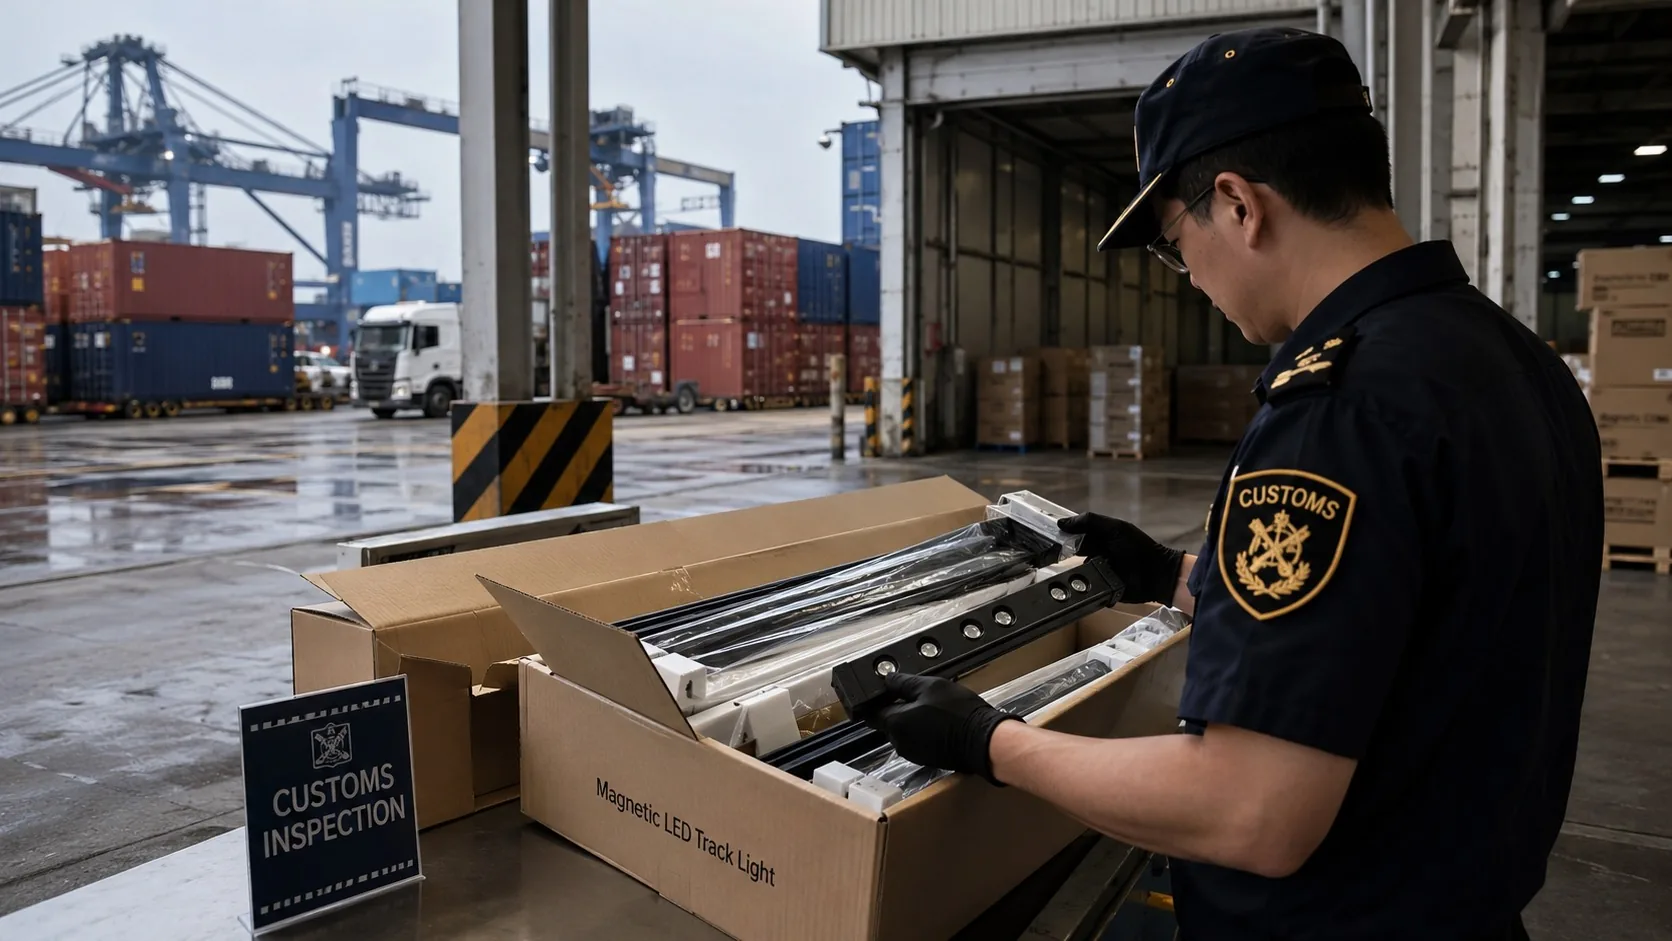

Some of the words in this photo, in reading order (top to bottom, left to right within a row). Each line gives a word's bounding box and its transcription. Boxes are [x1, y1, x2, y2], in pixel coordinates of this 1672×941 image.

[1239, 485, 1340, 520] CUSTOMS
[272, 763, 395, 817] CUSTOMS
[263, 794, 406, 859] INSPECTION
[596, 777, 661, 828] Magnetic
[664, 812, 692, 843] LED
[695, 828, 734, 866] Track
[738, 850, 776, 888] Light
